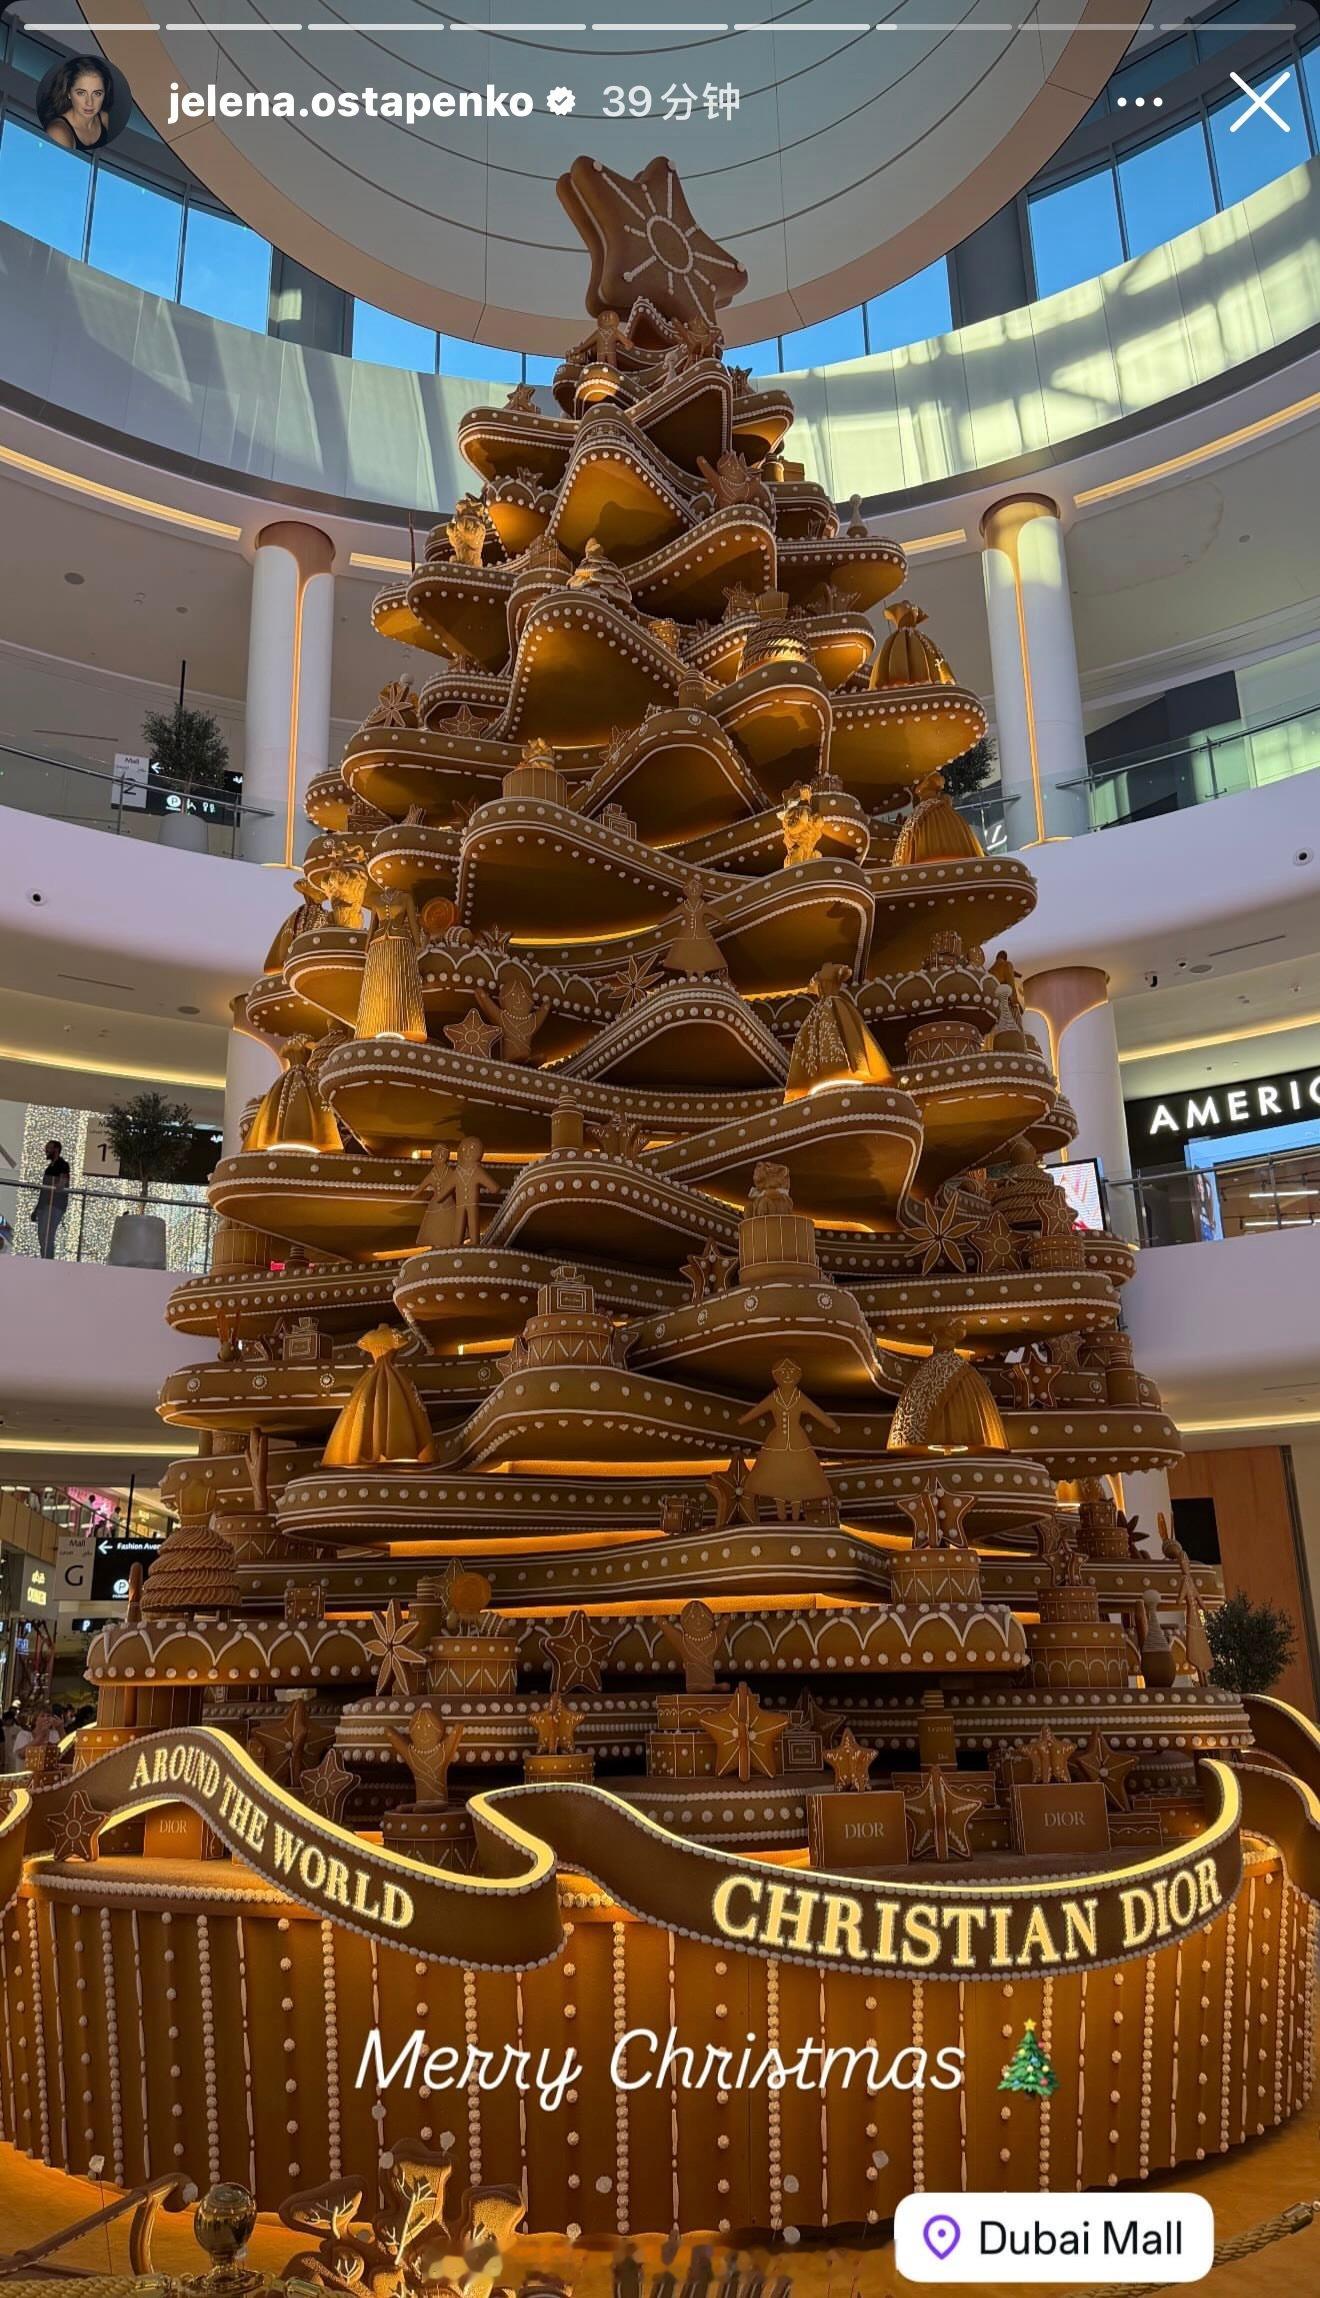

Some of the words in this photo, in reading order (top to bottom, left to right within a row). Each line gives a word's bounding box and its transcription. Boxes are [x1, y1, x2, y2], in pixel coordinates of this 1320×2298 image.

[97, 1143, 107, 1162] 1
[69, 1538, 86, 1547] Mall
[117, 1541, 143, 1550] Fashion
[64, 1564, 84, 1587] G
[159, 1819, 188, 1833] DIOR
[1043, 1810, 1087, 1827] DIOR
[129, 1745, 221, 1800] AROUND
[218, 1773, 269, 1853] THE
[272, 1822, 416, 1930] WORLD
[844, 1822, 885, 1839] DIOR
[712, 1874, 1099, 1968] CHRISTIAN
[1119, 1856, 1224, 1949] DIOR
